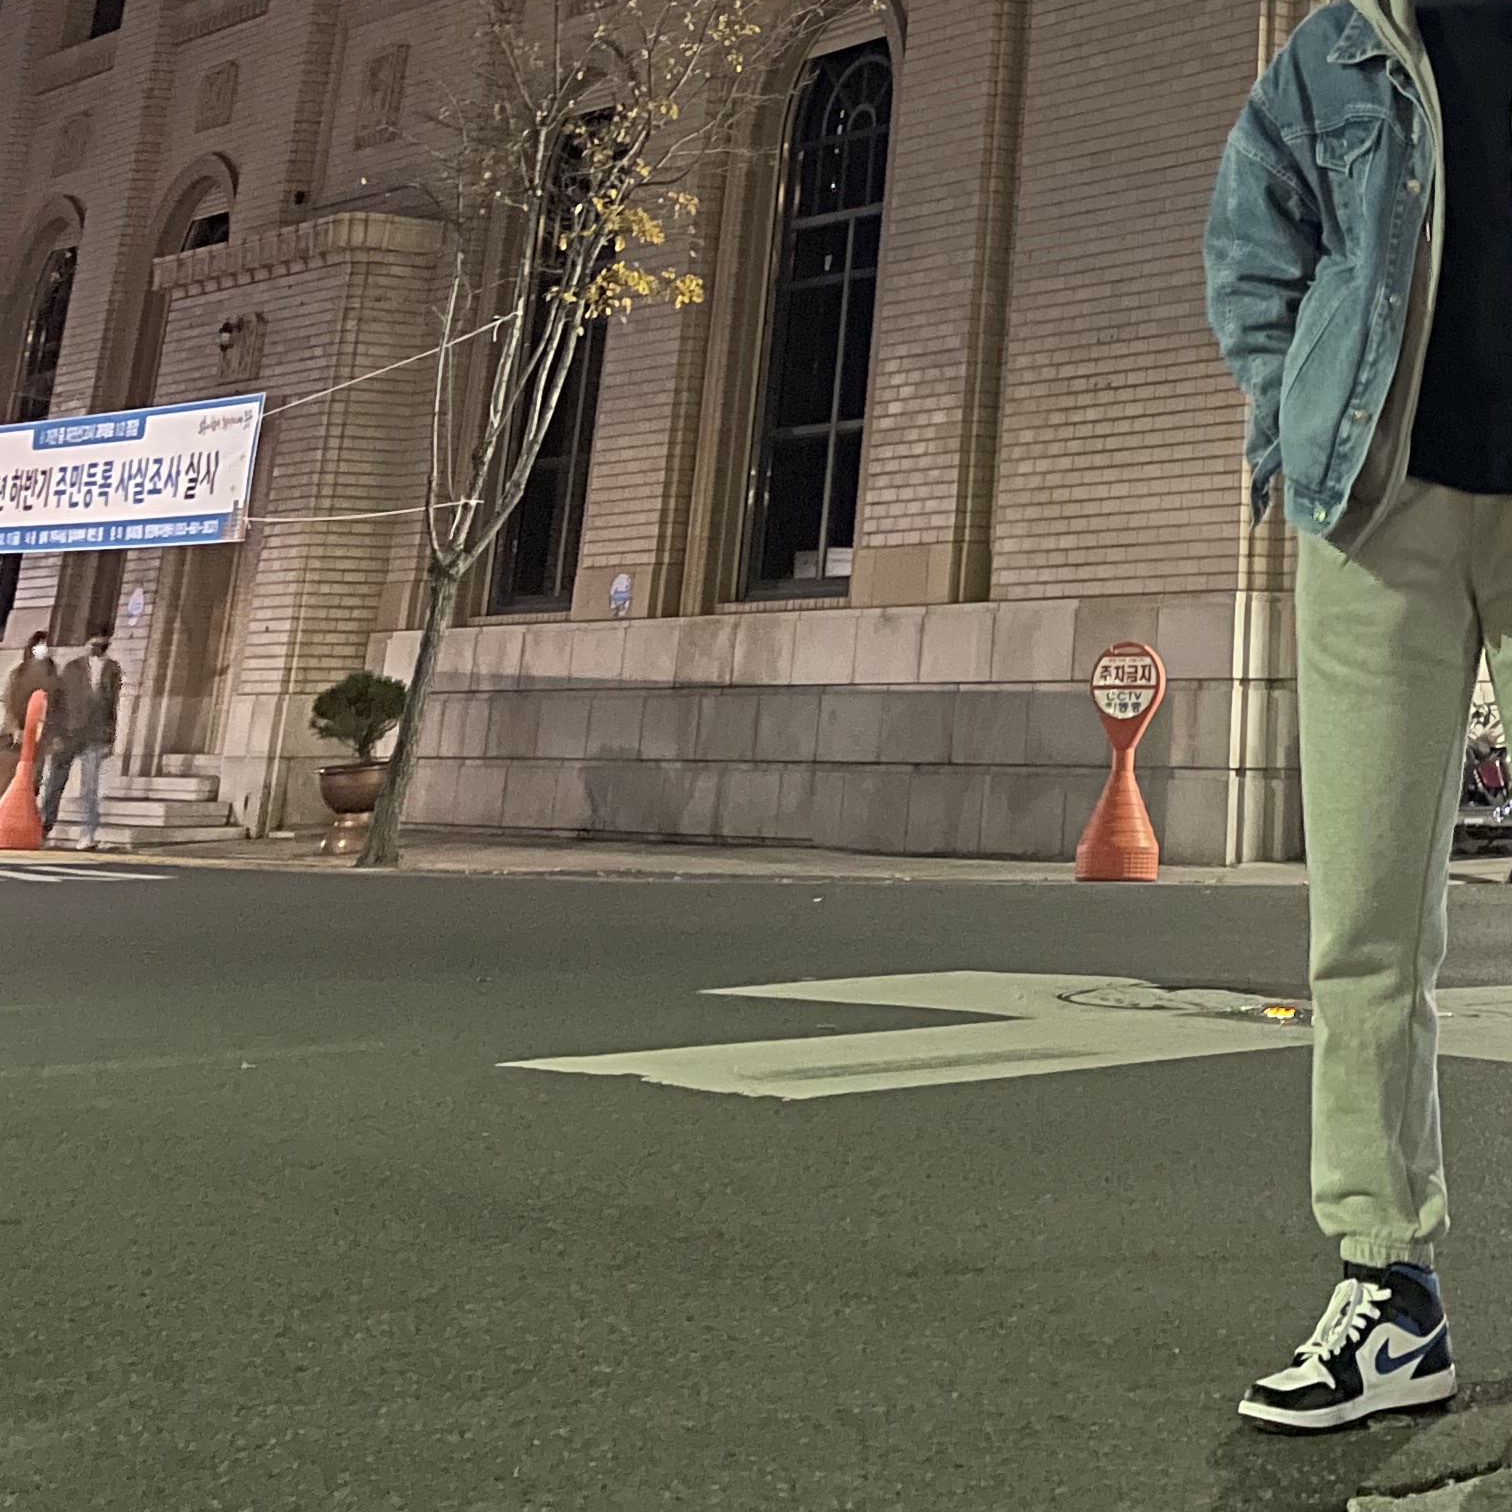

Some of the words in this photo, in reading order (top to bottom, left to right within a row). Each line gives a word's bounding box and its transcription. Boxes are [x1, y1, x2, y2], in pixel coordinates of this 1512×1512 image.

[9, 467, 53, 511] 하반기
[53, 460, 115, 509] 주민등록
[114, 454, 182, 505] 사실조사
[183, 449, 220, 500] 실시
[1099, 664, 1152, 683] 주차금지
[1106, 691, 1143, 702] CCTV
